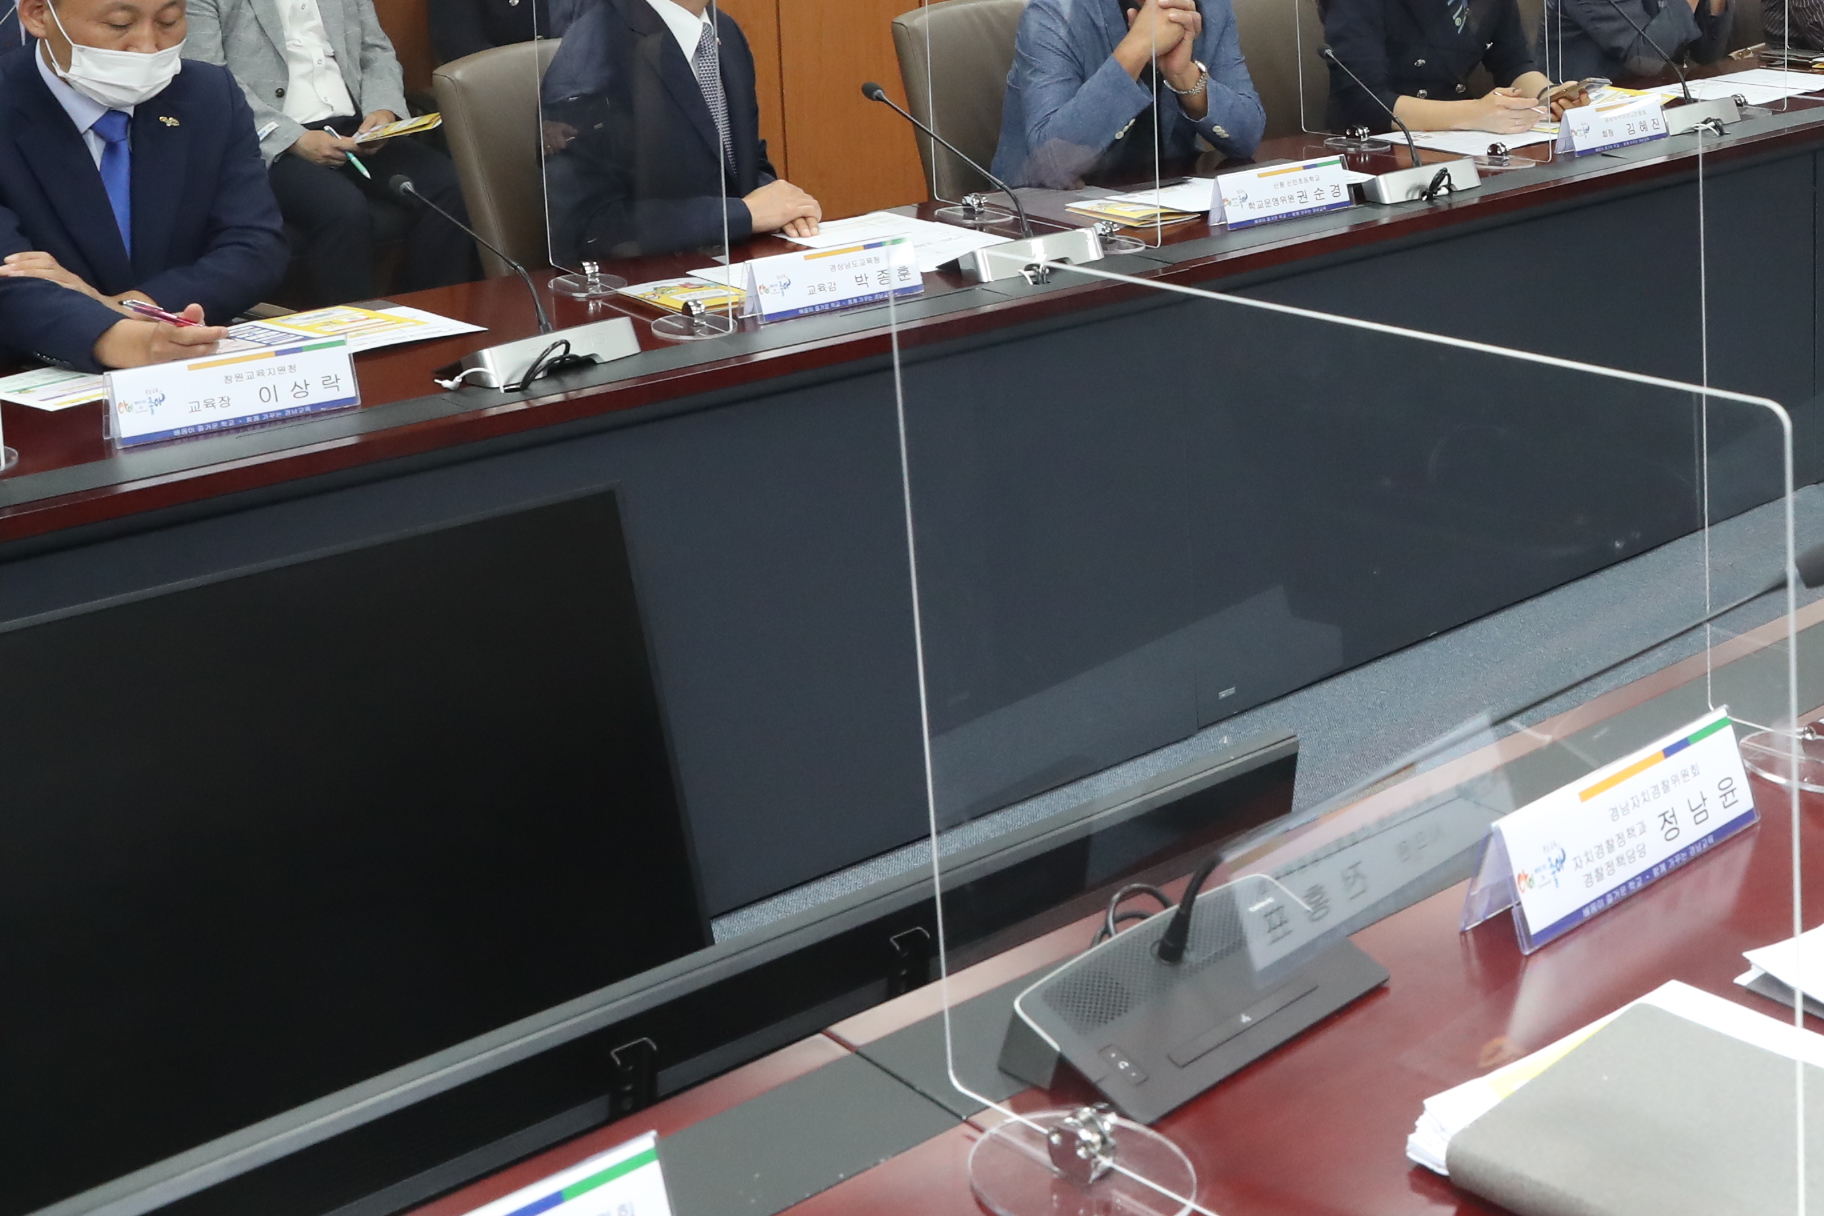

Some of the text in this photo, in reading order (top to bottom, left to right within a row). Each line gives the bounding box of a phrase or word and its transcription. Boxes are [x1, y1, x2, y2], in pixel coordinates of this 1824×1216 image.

[1248, 194, 1295, 210] 학교운영위원
[829, 256, 881, 272] 경상남도교육청
[807, 281, 837, 296] 교육감
[188, 395, 231, 413] 교육장
[1607, 763, 1701, 822] 경남자치경찰위원회
[1572, 820, 1648, 872] 자치경찰정책과
[1582, 842, 1648, 889] 경찰정책담당
